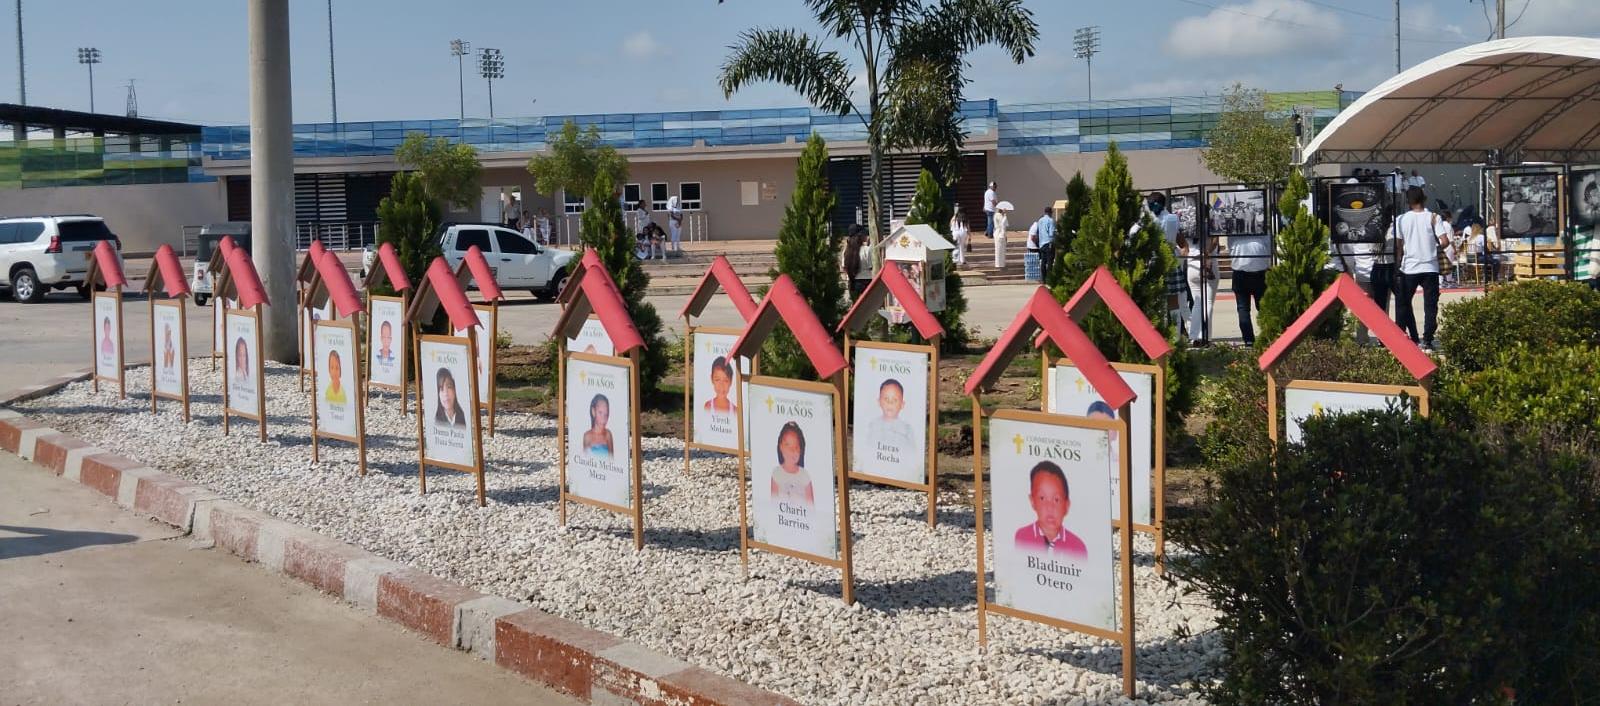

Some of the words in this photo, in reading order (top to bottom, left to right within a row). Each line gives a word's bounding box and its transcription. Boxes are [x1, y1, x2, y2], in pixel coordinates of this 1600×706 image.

[879, 363, 887, 372] 10
[889, 363, 911, 375] AÑOS
[587, 378, 595, 387] 10
[596, 377, 615, 390] AÑOS
[776, 404, 785, 415] 10
[787, 404, 814, 418] AÑOS
[877, 441, 899, 453] Lucas
[1028, 444, 1041, 457] 10
[1043, 444, 1081, 461] AÑOS
[574, 454, 598, 468] Claudia
[599, 460, 624, 474] Melissa
[876, 452, 900, 464] Rocha
[779, 502, 807, 517] Charit
[777, 514, 810, 530] Barrios
[1027, 555, 1082, 577] Bladimir
[1036, 573, 1073, 592] Otero
